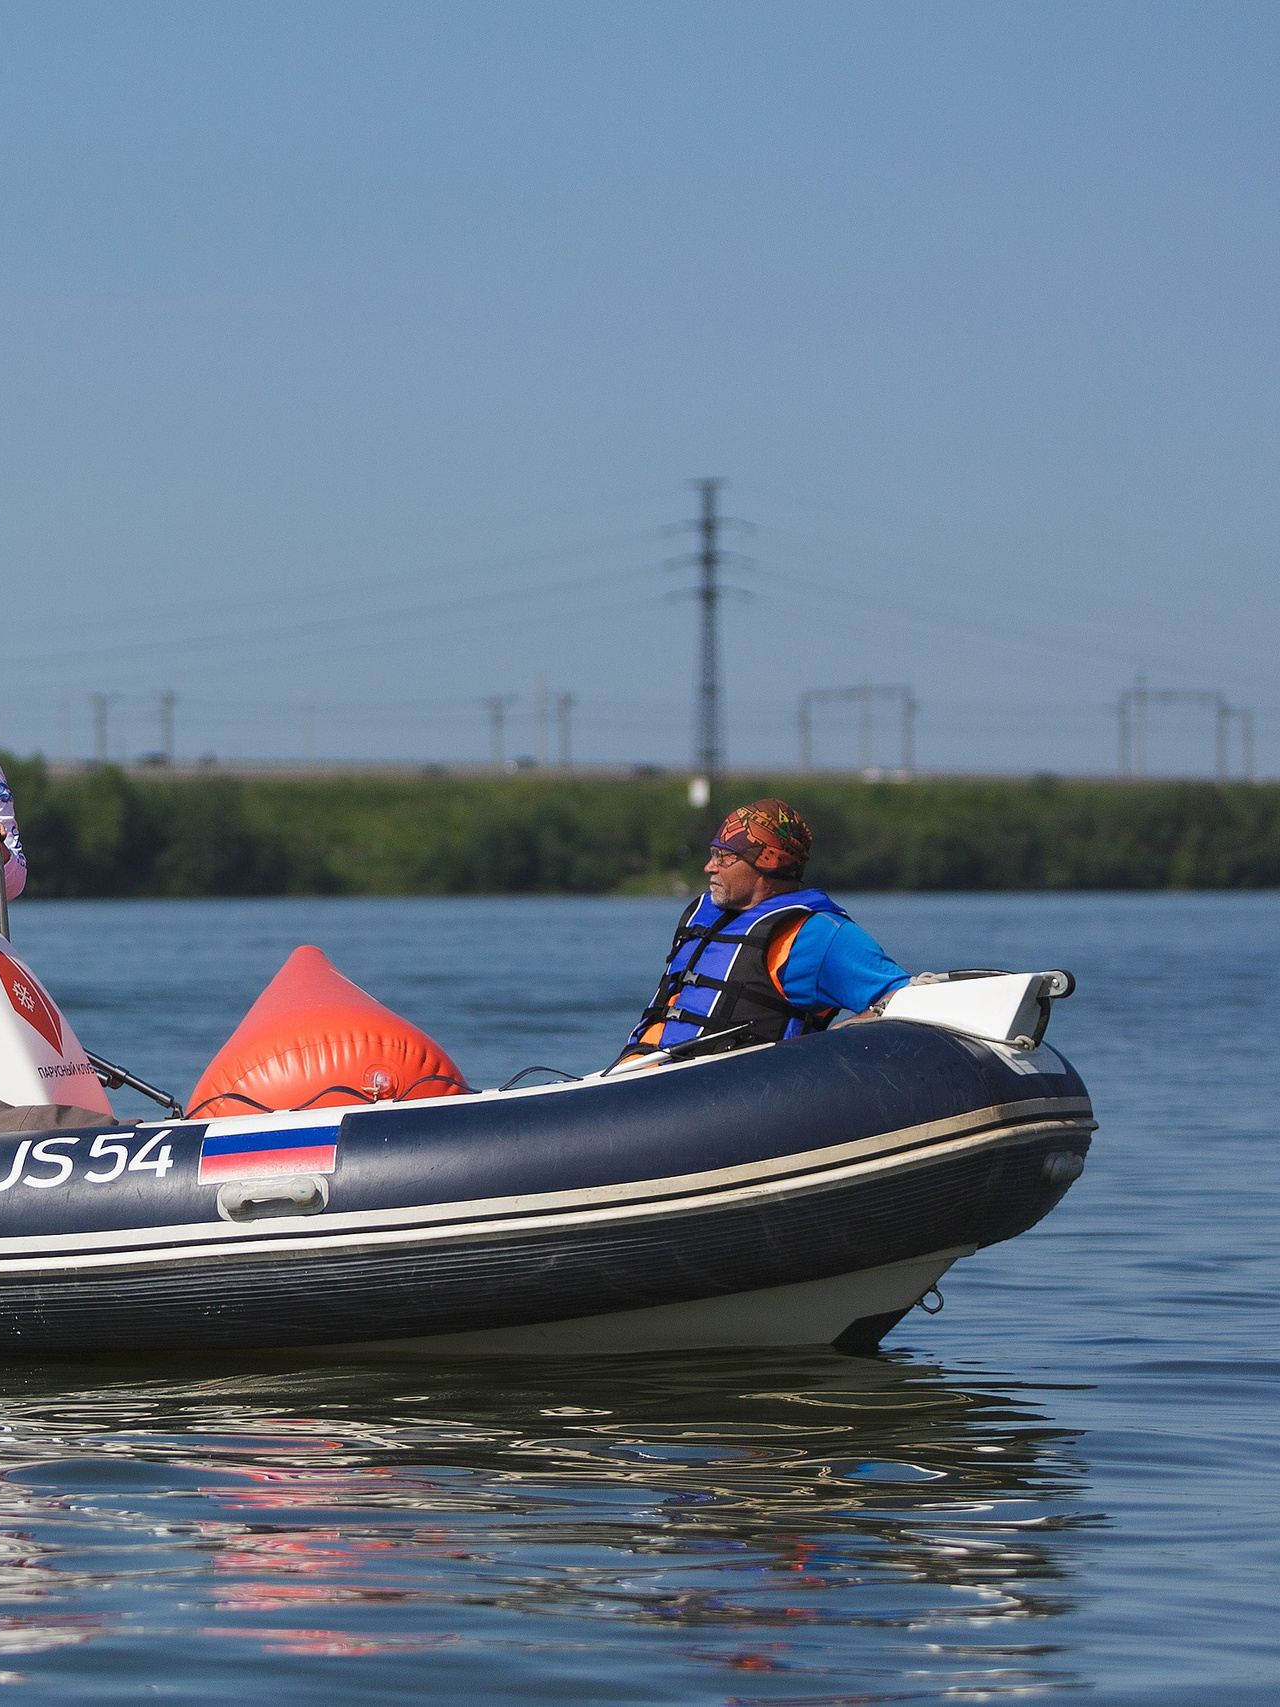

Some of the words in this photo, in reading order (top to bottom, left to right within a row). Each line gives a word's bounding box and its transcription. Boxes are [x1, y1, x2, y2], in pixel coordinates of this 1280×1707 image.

[37, 1061, 76, 1079] ПАРУСНЫЙ
[77, 1063, 94, 1076] КЛУБ
[82, 1130, 174, 1185] 54
